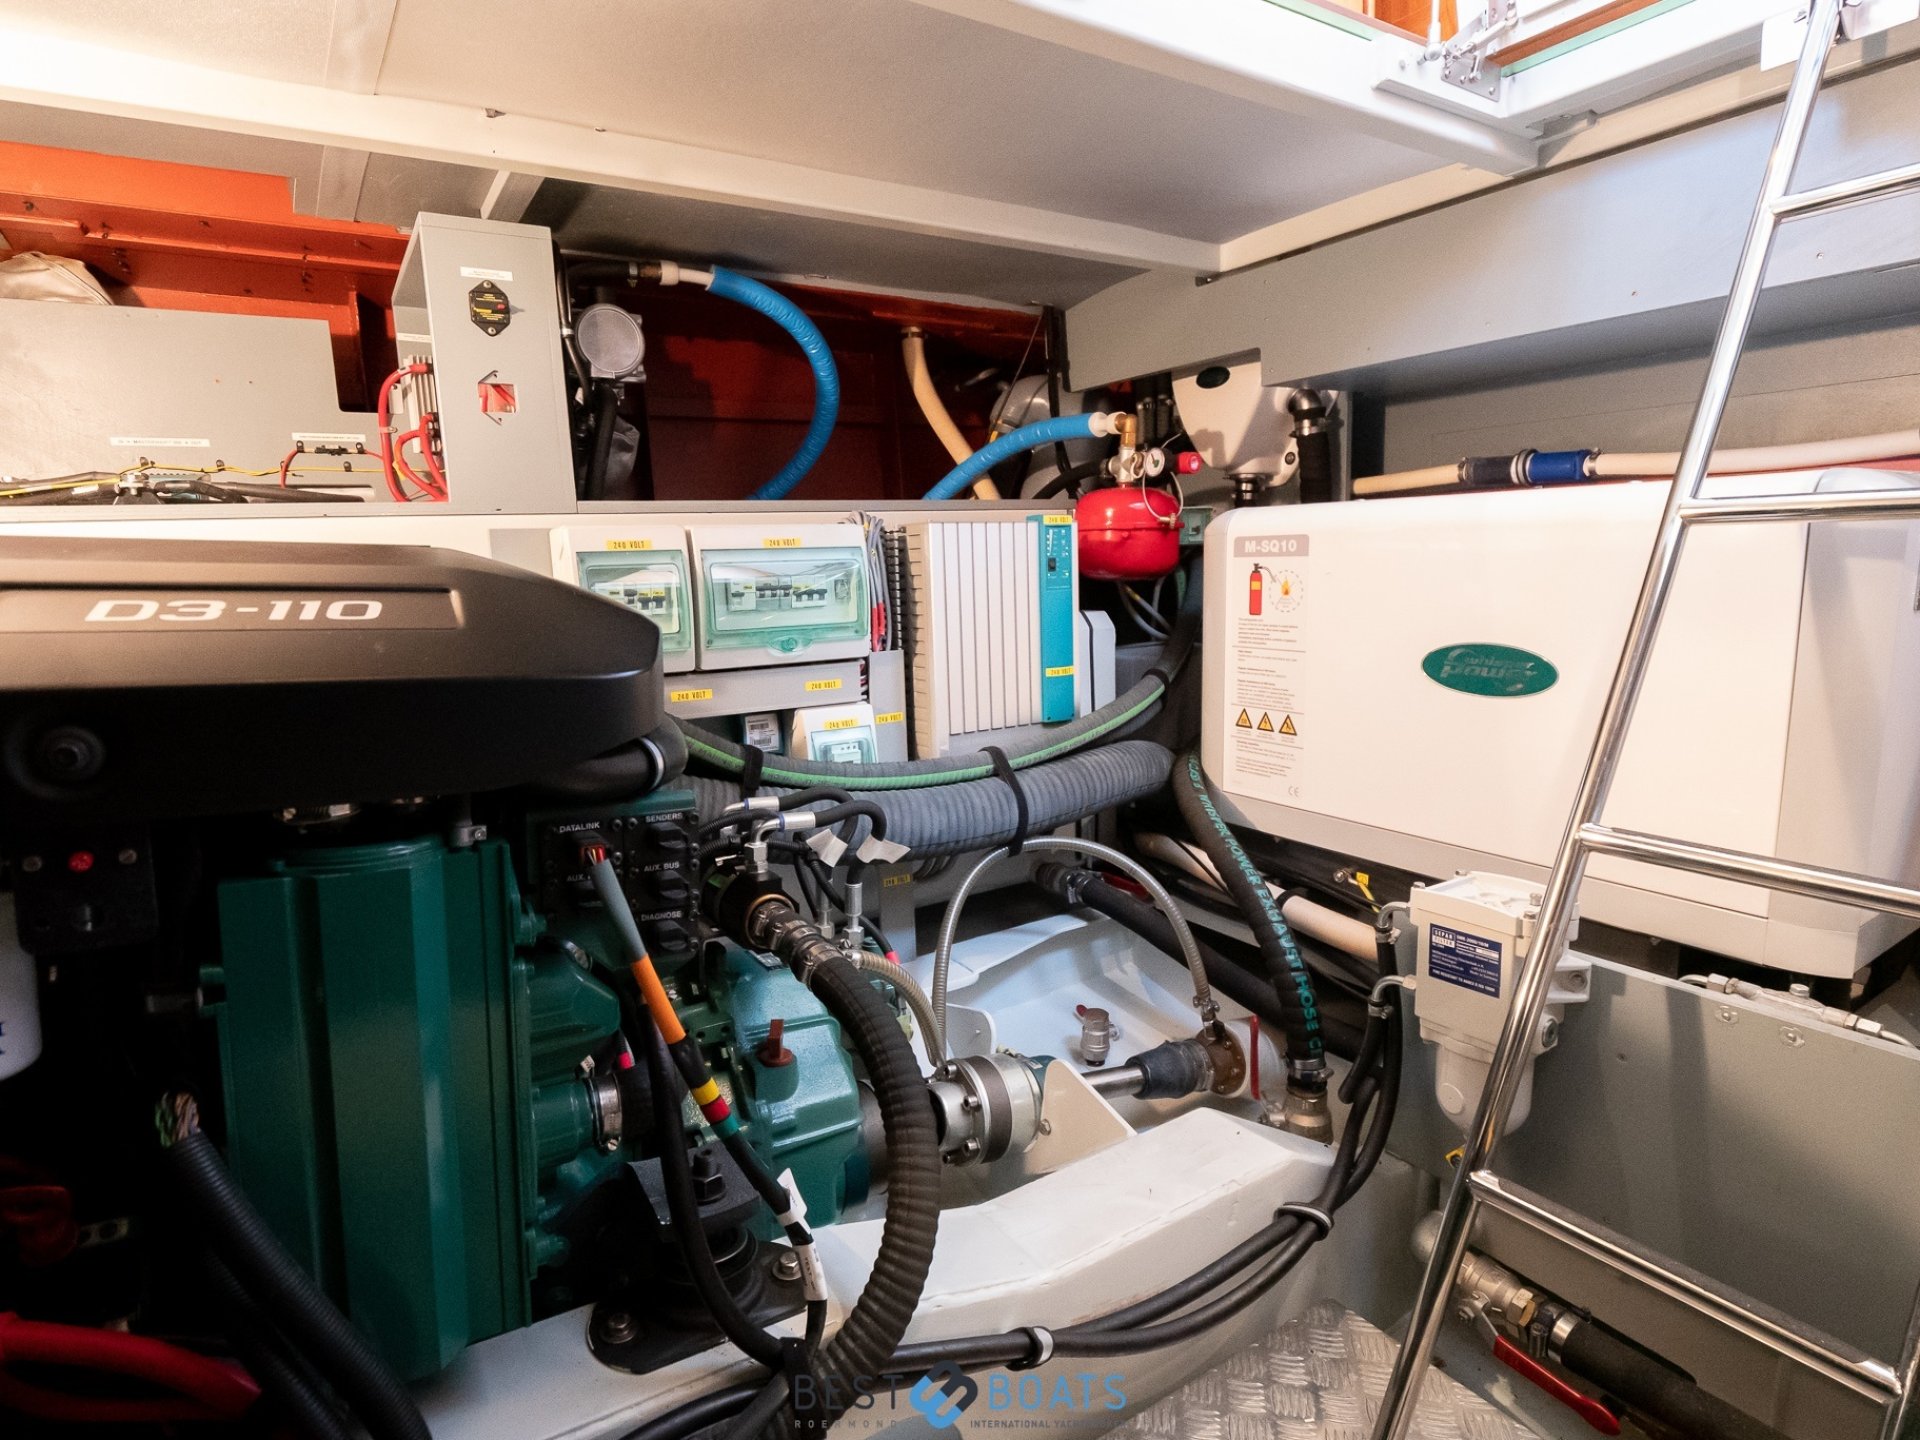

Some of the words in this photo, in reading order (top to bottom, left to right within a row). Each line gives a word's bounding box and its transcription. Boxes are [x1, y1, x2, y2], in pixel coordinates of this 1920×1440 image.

[613, 541, 627, 550] 240
[630, 540, 645, 549] VOLT
[769, 539, 781, 548] 240
[783, 538, 796, 547] VOLT
[1244, 539, 1297, 553] M-SQ10
[84, 600, 382, 622] D3-110
[811, 682, 822, 690] 240
[824, 680, 836, 689] VOLT
[677, 691, 689, 700] 240
[692, 690, 706, 700] VOLT
[878, 715, 888, 723] 240
[889, 713, 902, 722] VOLT
[829, 721, 840, 730] 240
[841, 719, 854, 728] VOLT
[645, 813, 683, 823] SENDERS
[559, 822, 600, 833] DATALINK
[644, 865, 661, 873] AUX.
[663, 862, 680, 870] BUS
[641, 911, 682, 921] DIAGNOSE
[1225, 836, 1261, 886] POWER
[1257, 888, 1304, 971] EXHAUST
[1290, 972, 1321, 1032] HOSE
